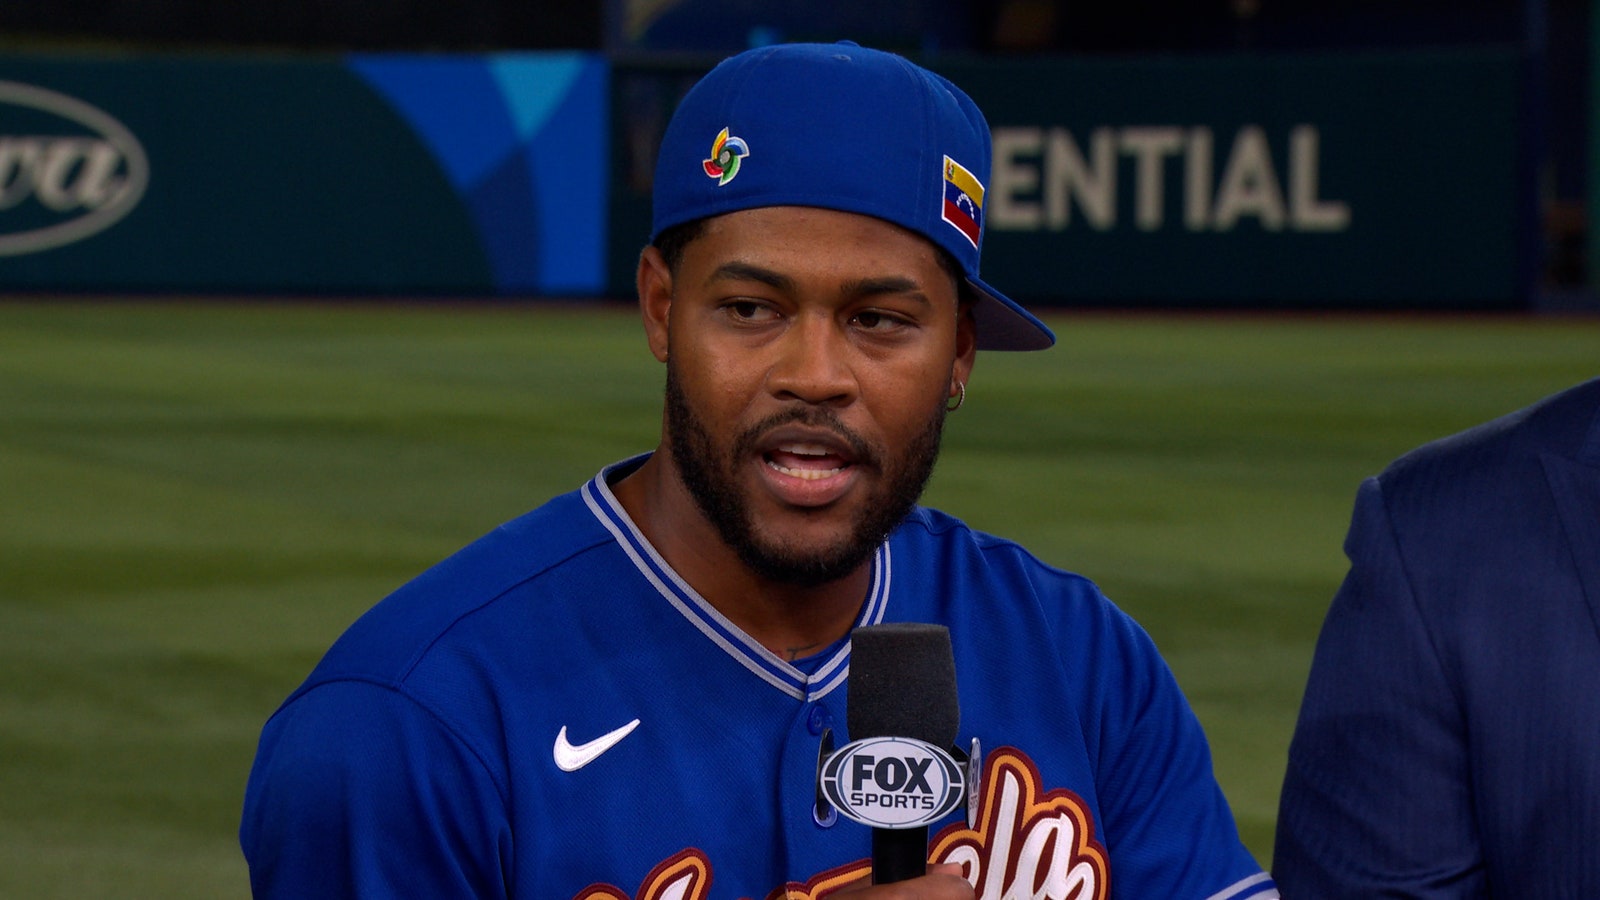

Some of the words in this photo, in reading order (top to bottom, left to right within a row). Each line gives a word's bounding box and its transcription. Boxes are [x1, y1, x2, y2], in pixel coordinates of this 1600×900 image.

[990, 125, 1350, 231] ENTIAL
[852, 755, 934, 794] FOX
[850, 792, 935, 809] SPORTS
